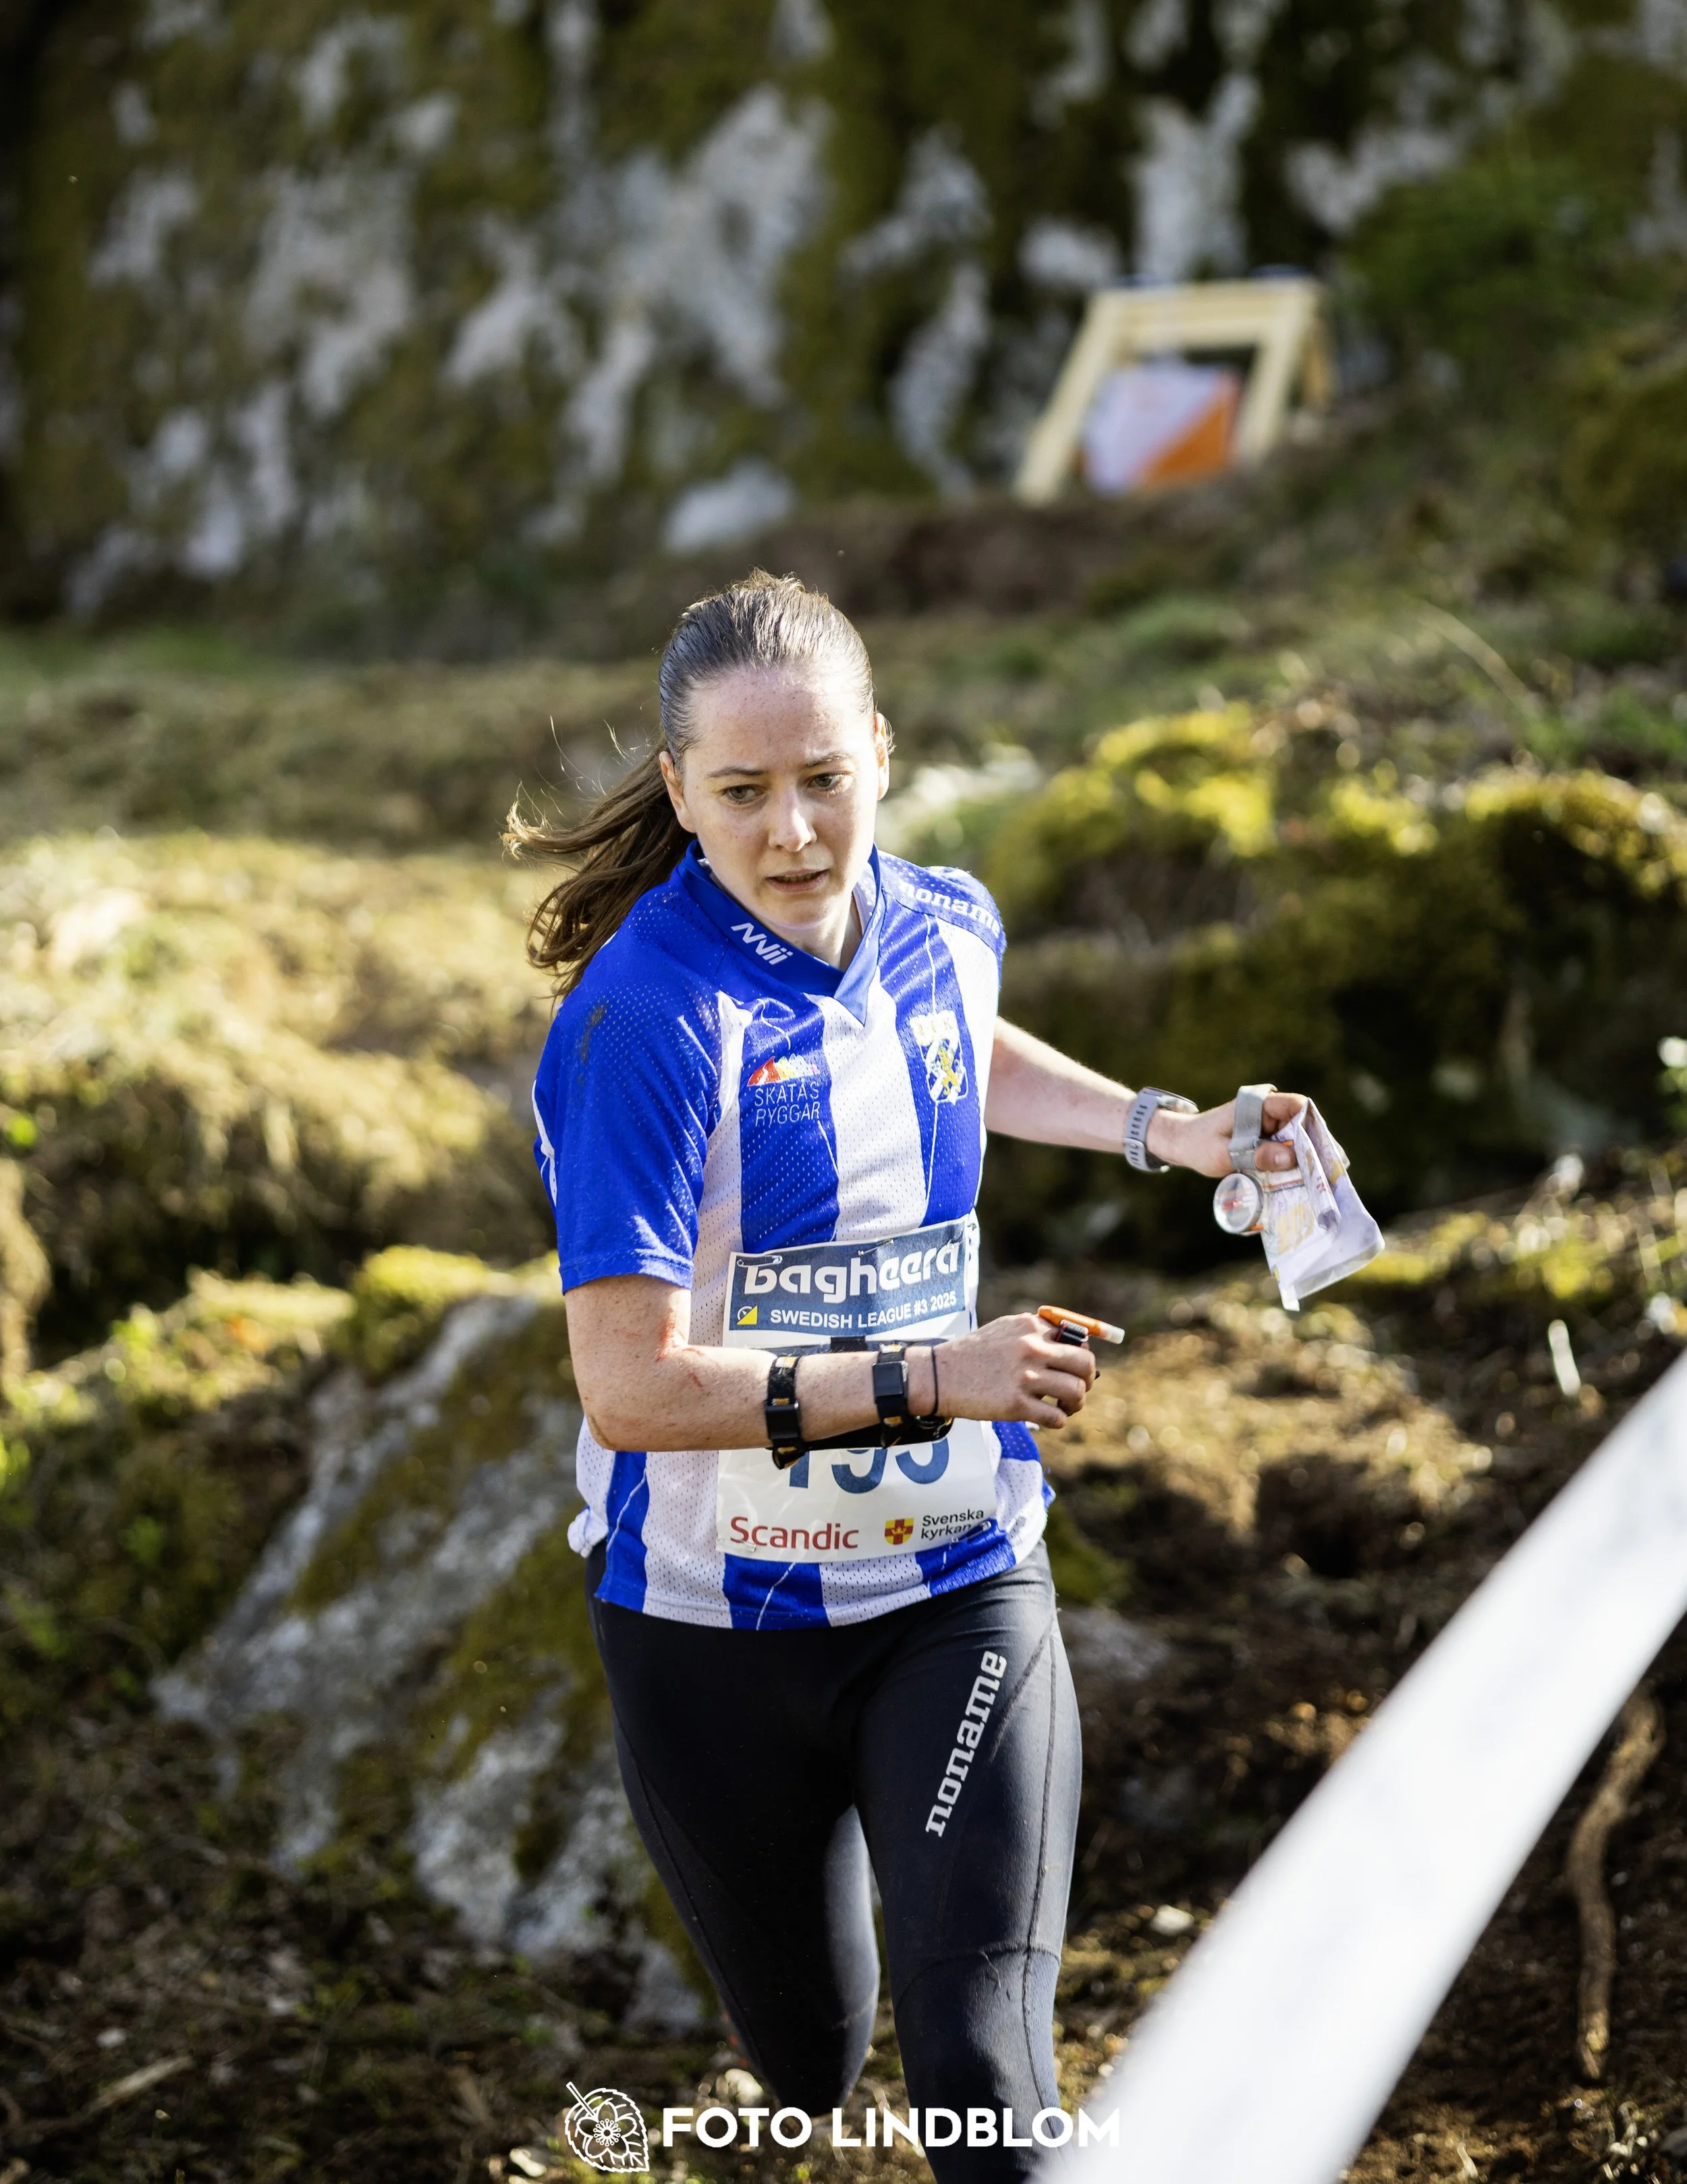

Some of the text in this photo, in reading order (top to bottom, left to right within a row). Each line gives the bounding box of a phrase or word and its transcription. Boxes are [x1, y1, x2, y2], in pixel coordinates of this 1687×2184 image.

[754, 1078, 819, 1107] SKATÅS
[755, 1101, 821, 1127] RYGGAR
[744, 1240, 960, 1303] bagheera
[770, 1290, 957, 1329] SWEDISH LEAGUE #3 2025
[730, 1516, 859, 1550] Scandic
[922, 1508, 985, 1527] Svenska
[925, 1651, 1007, 1837] noname
